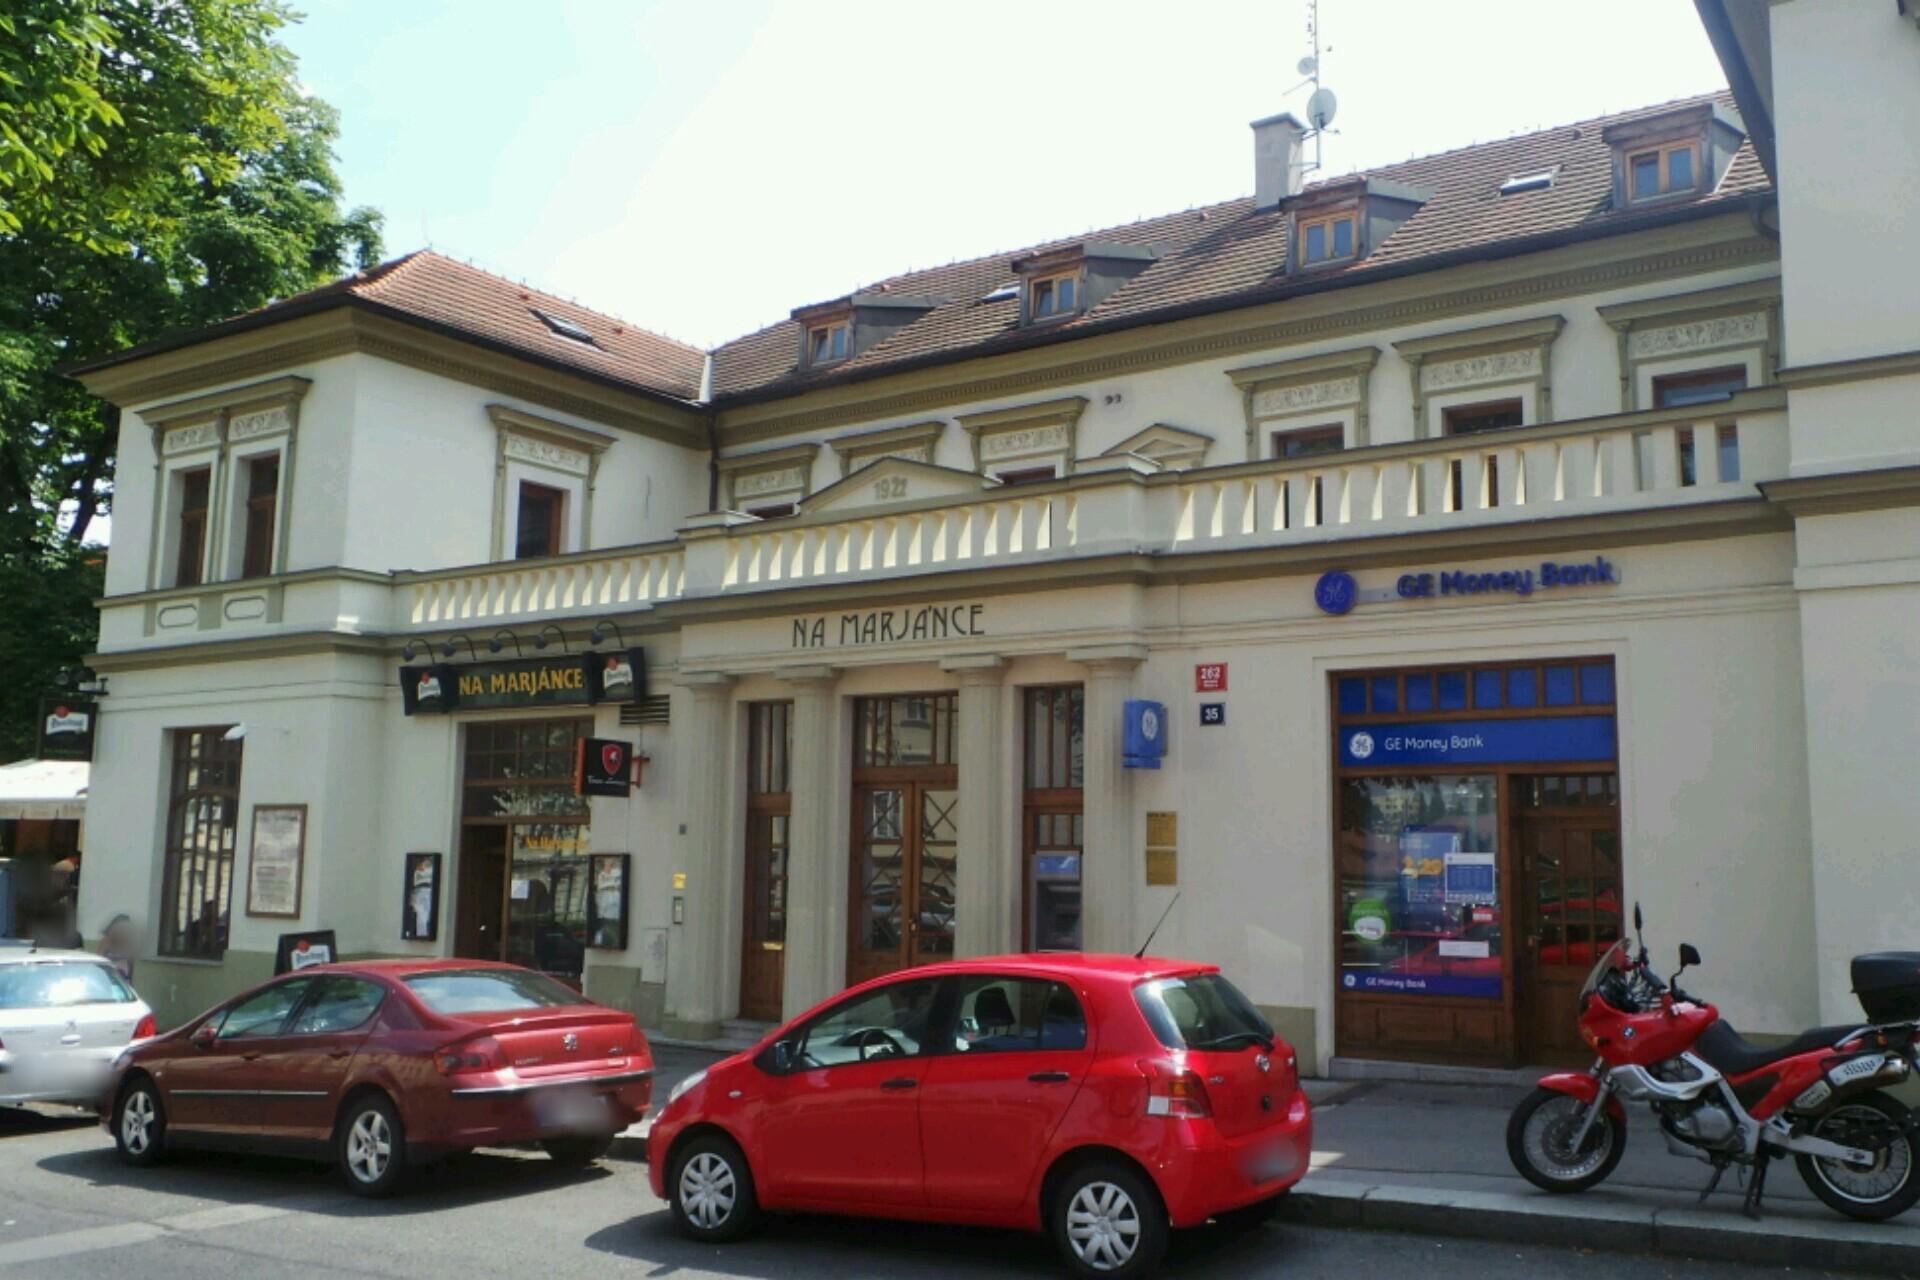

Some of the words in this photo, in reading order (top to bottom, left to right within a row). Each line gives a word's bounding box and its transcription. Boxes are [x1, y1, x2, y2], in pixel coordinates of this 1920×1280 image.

[1397, 573, 1434, 598] GE
[1441, 567, 1533, 596] Money
[1540, 555, 1614, 586] Bank
[792, 617, 825, 647] NA
[840, 604, 985, 645] MARJÁNCE
[459, 675, 484, 695] NA
[491, 666, 583, 696] MARJÁNCE
[1384, 737, 1402, 751] GE
[1405, 737, 1448, 753] Money
[1451, 734, 1483, 749] Bank
